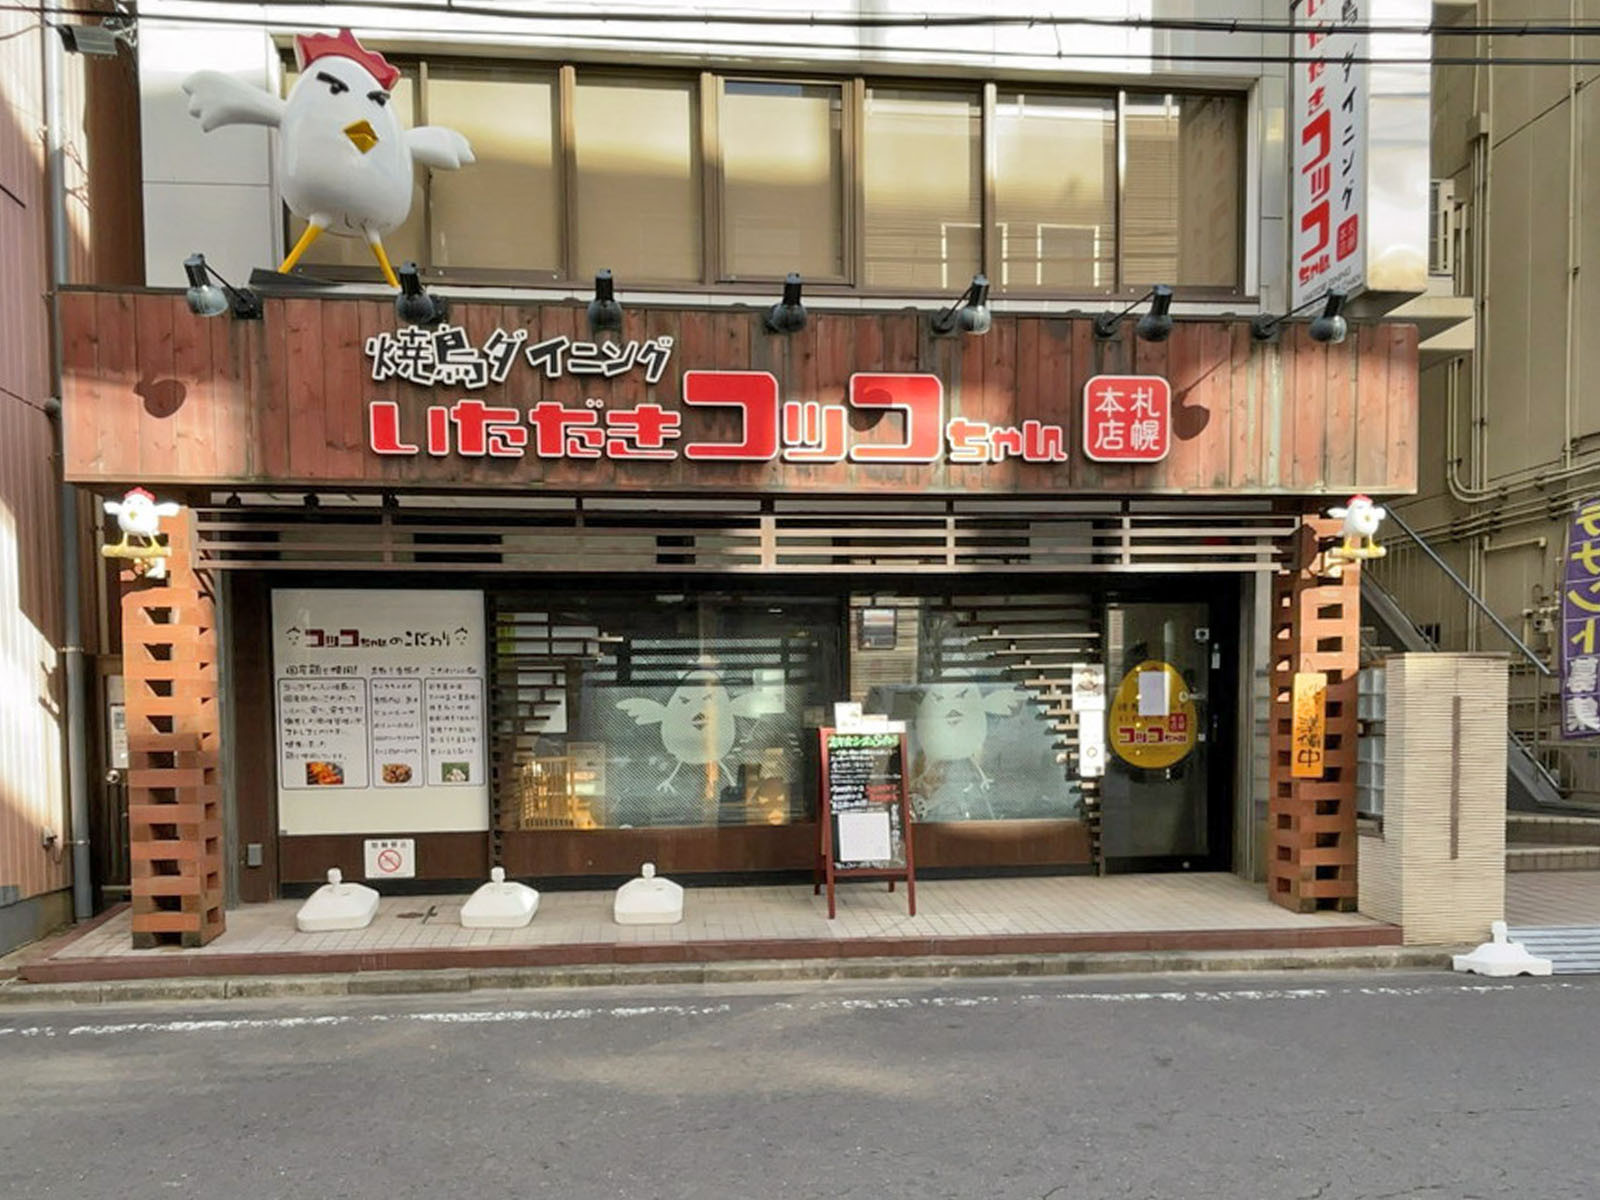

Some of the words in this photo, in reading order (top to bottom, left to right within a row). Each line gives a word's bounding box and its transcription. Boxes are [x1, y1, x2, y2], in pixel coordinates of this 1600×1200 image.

[366, 323, 674, 389] 焼鳥ダイニング
